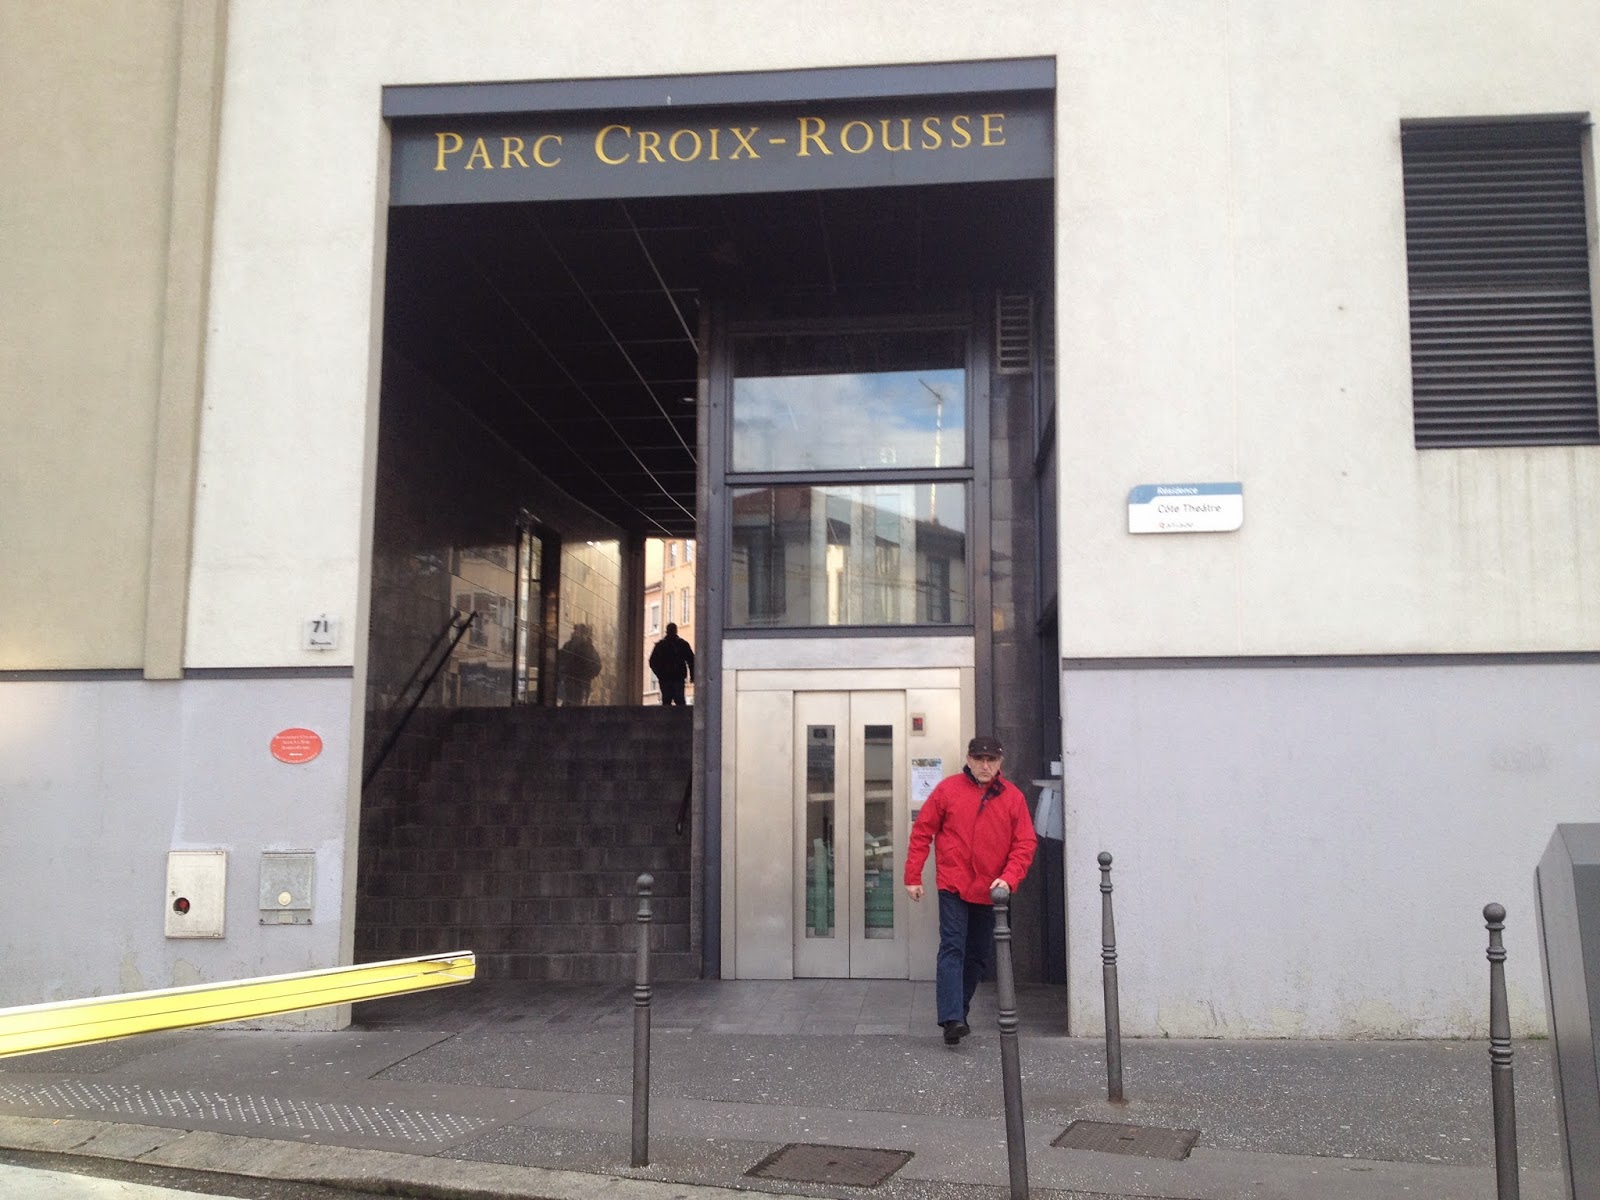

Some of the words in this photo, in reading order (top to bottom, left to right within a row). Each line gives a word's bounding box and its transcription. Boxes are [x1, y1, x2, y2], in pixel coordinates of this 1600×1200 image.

[433, 131, 564, 172] PARC
[593, 113, 1008, 165] CROIX-ROUSSE
[312, 620, 328, 633] 71
